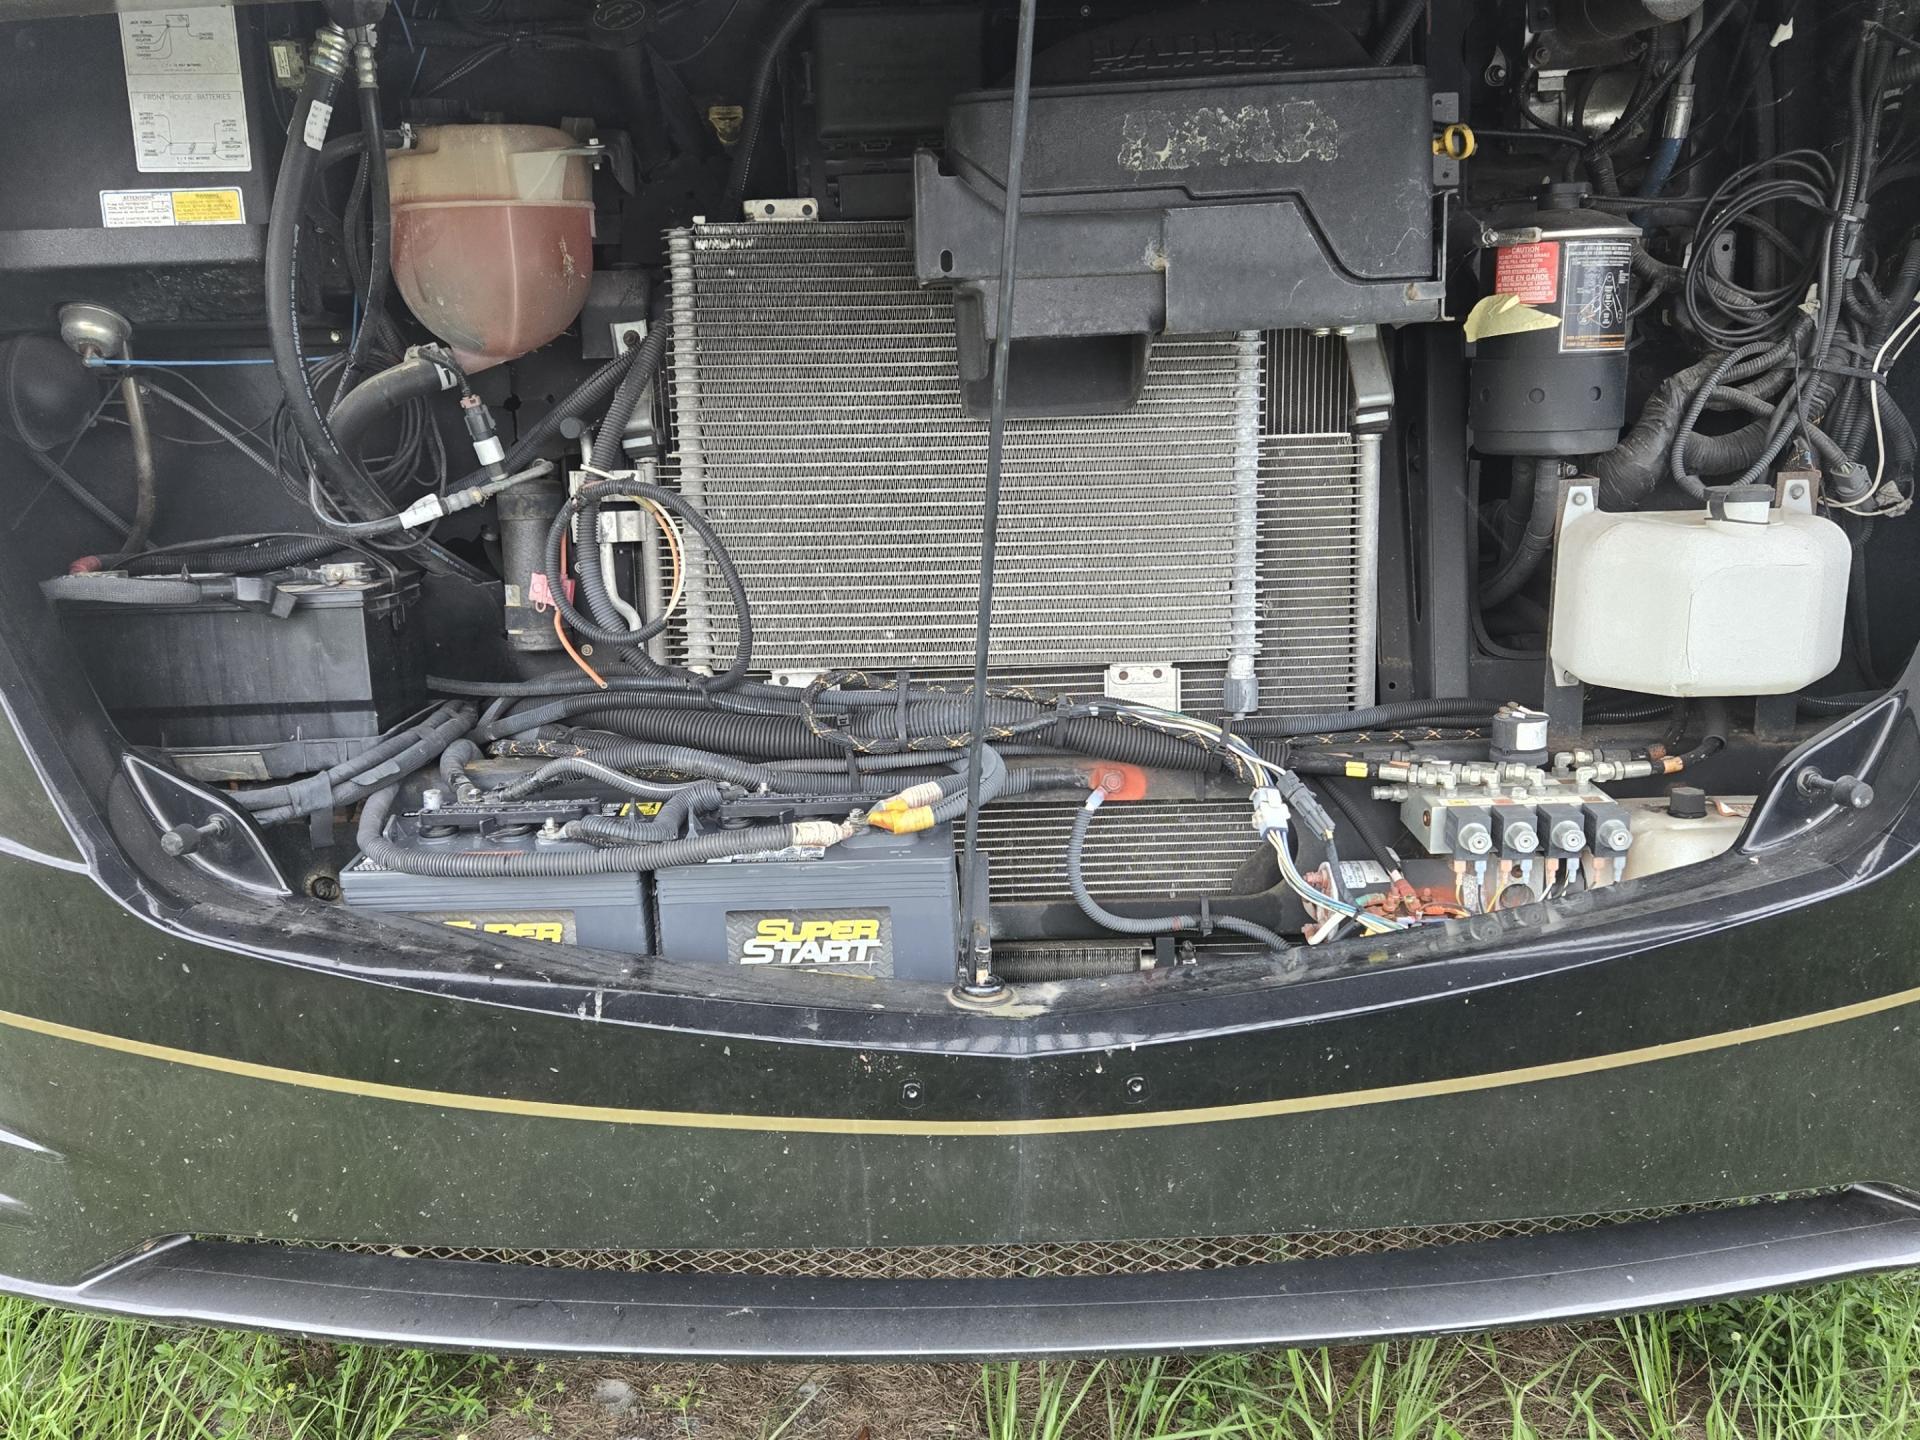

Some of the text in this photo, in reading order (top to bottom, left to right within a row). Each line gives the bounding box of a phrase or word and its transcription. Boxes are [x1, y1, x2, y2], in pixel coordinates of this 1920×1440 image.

[1512, 246, 1540, 254] CAUTION
[756, 918, 880, 942] SUPER
[740, 938, 882, 964] START
